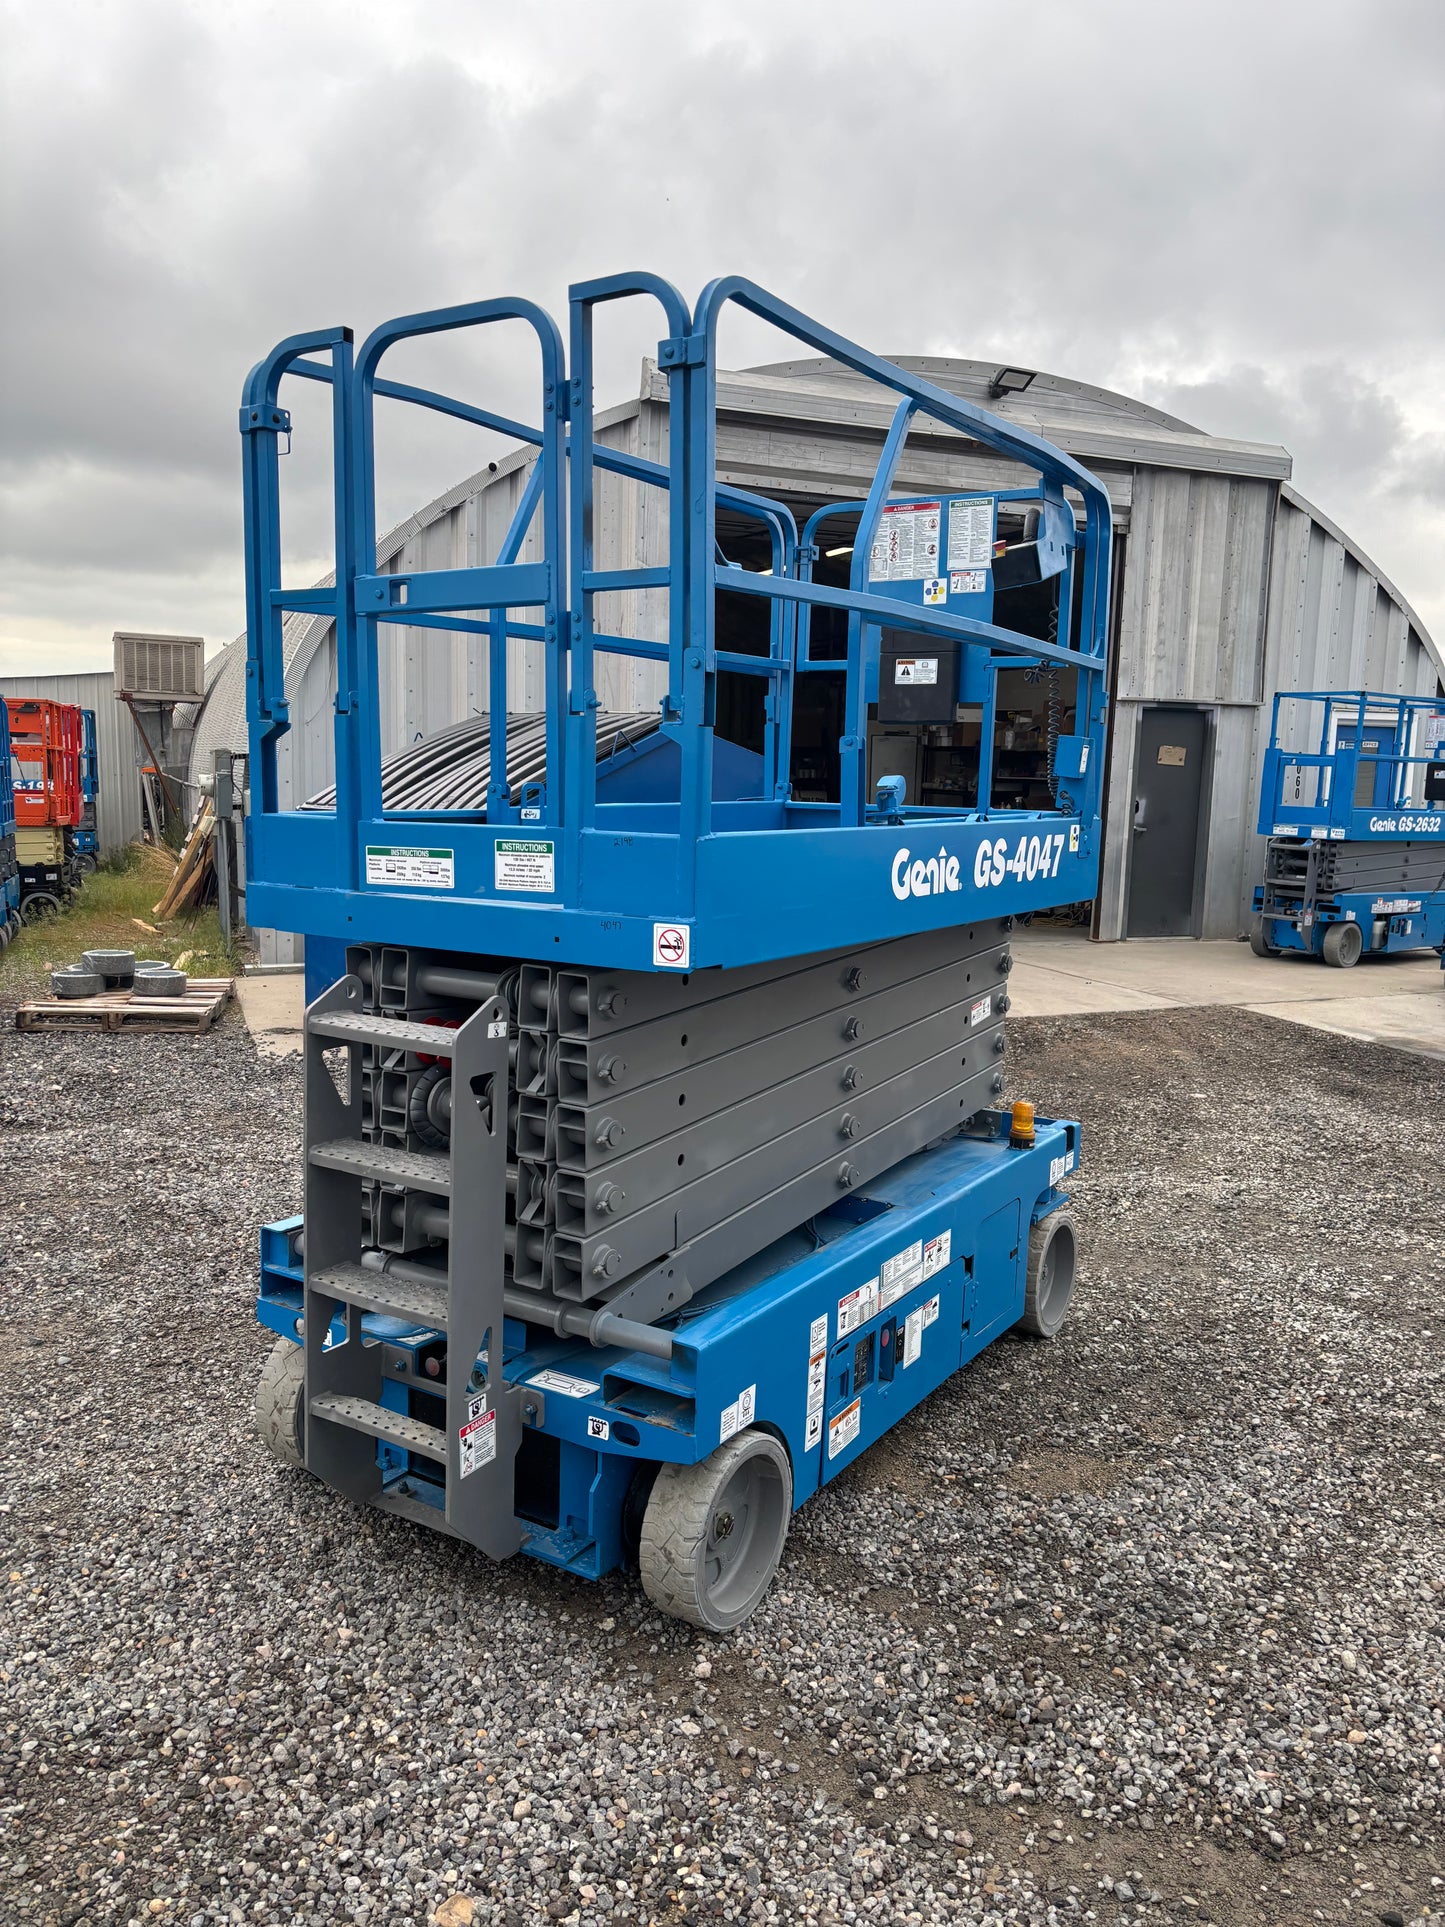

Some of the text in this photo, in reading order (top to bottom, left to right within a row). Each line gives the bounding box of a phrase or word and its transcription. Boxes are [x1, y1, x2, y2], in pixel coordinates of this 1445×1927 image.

[1370, 816, 1441, 832] Genie GS-2632
[390, 849, 430, 857] INSTRUCTIONS
[502, 843, 547, 852] INSTRUCTIONS
[891, 834, 1065, 900] Genie GS-4047
[470, 1413, 491, 1431] DANGER
